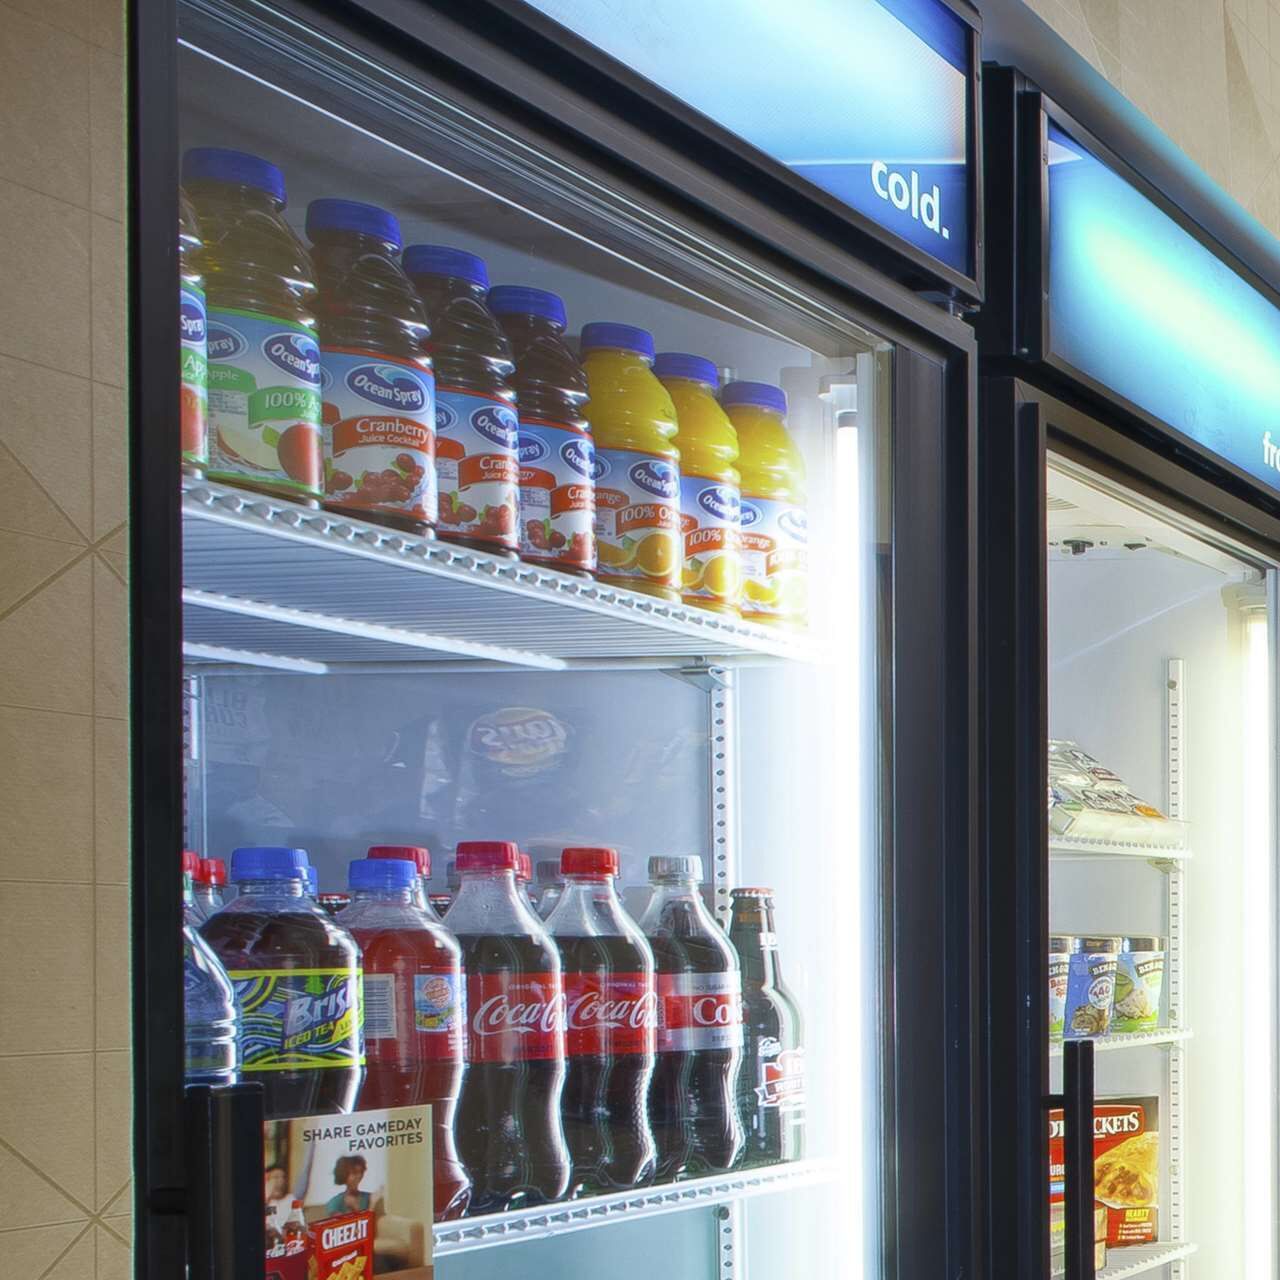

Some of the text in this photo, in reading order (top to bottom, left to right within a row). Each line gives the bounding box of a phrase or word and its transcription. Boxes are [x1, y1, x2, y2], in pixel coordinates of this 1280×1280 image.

[871, 160, 949, 239] cold.
[354, 374, 422, 405] Ocean Spray
[356, 418, 430, 444] Cranberry
[621, 507, 655, 524] 100%
[690, 528, 721, 547] 100%
[291, 987, 350, 1025] Bris
[303, 1118, 422, 1142] SHARE GAMEDAY
[1094, 1112, 1139, 1135] CKETS
[349, 1132, 423, 1151] FAVORITES
